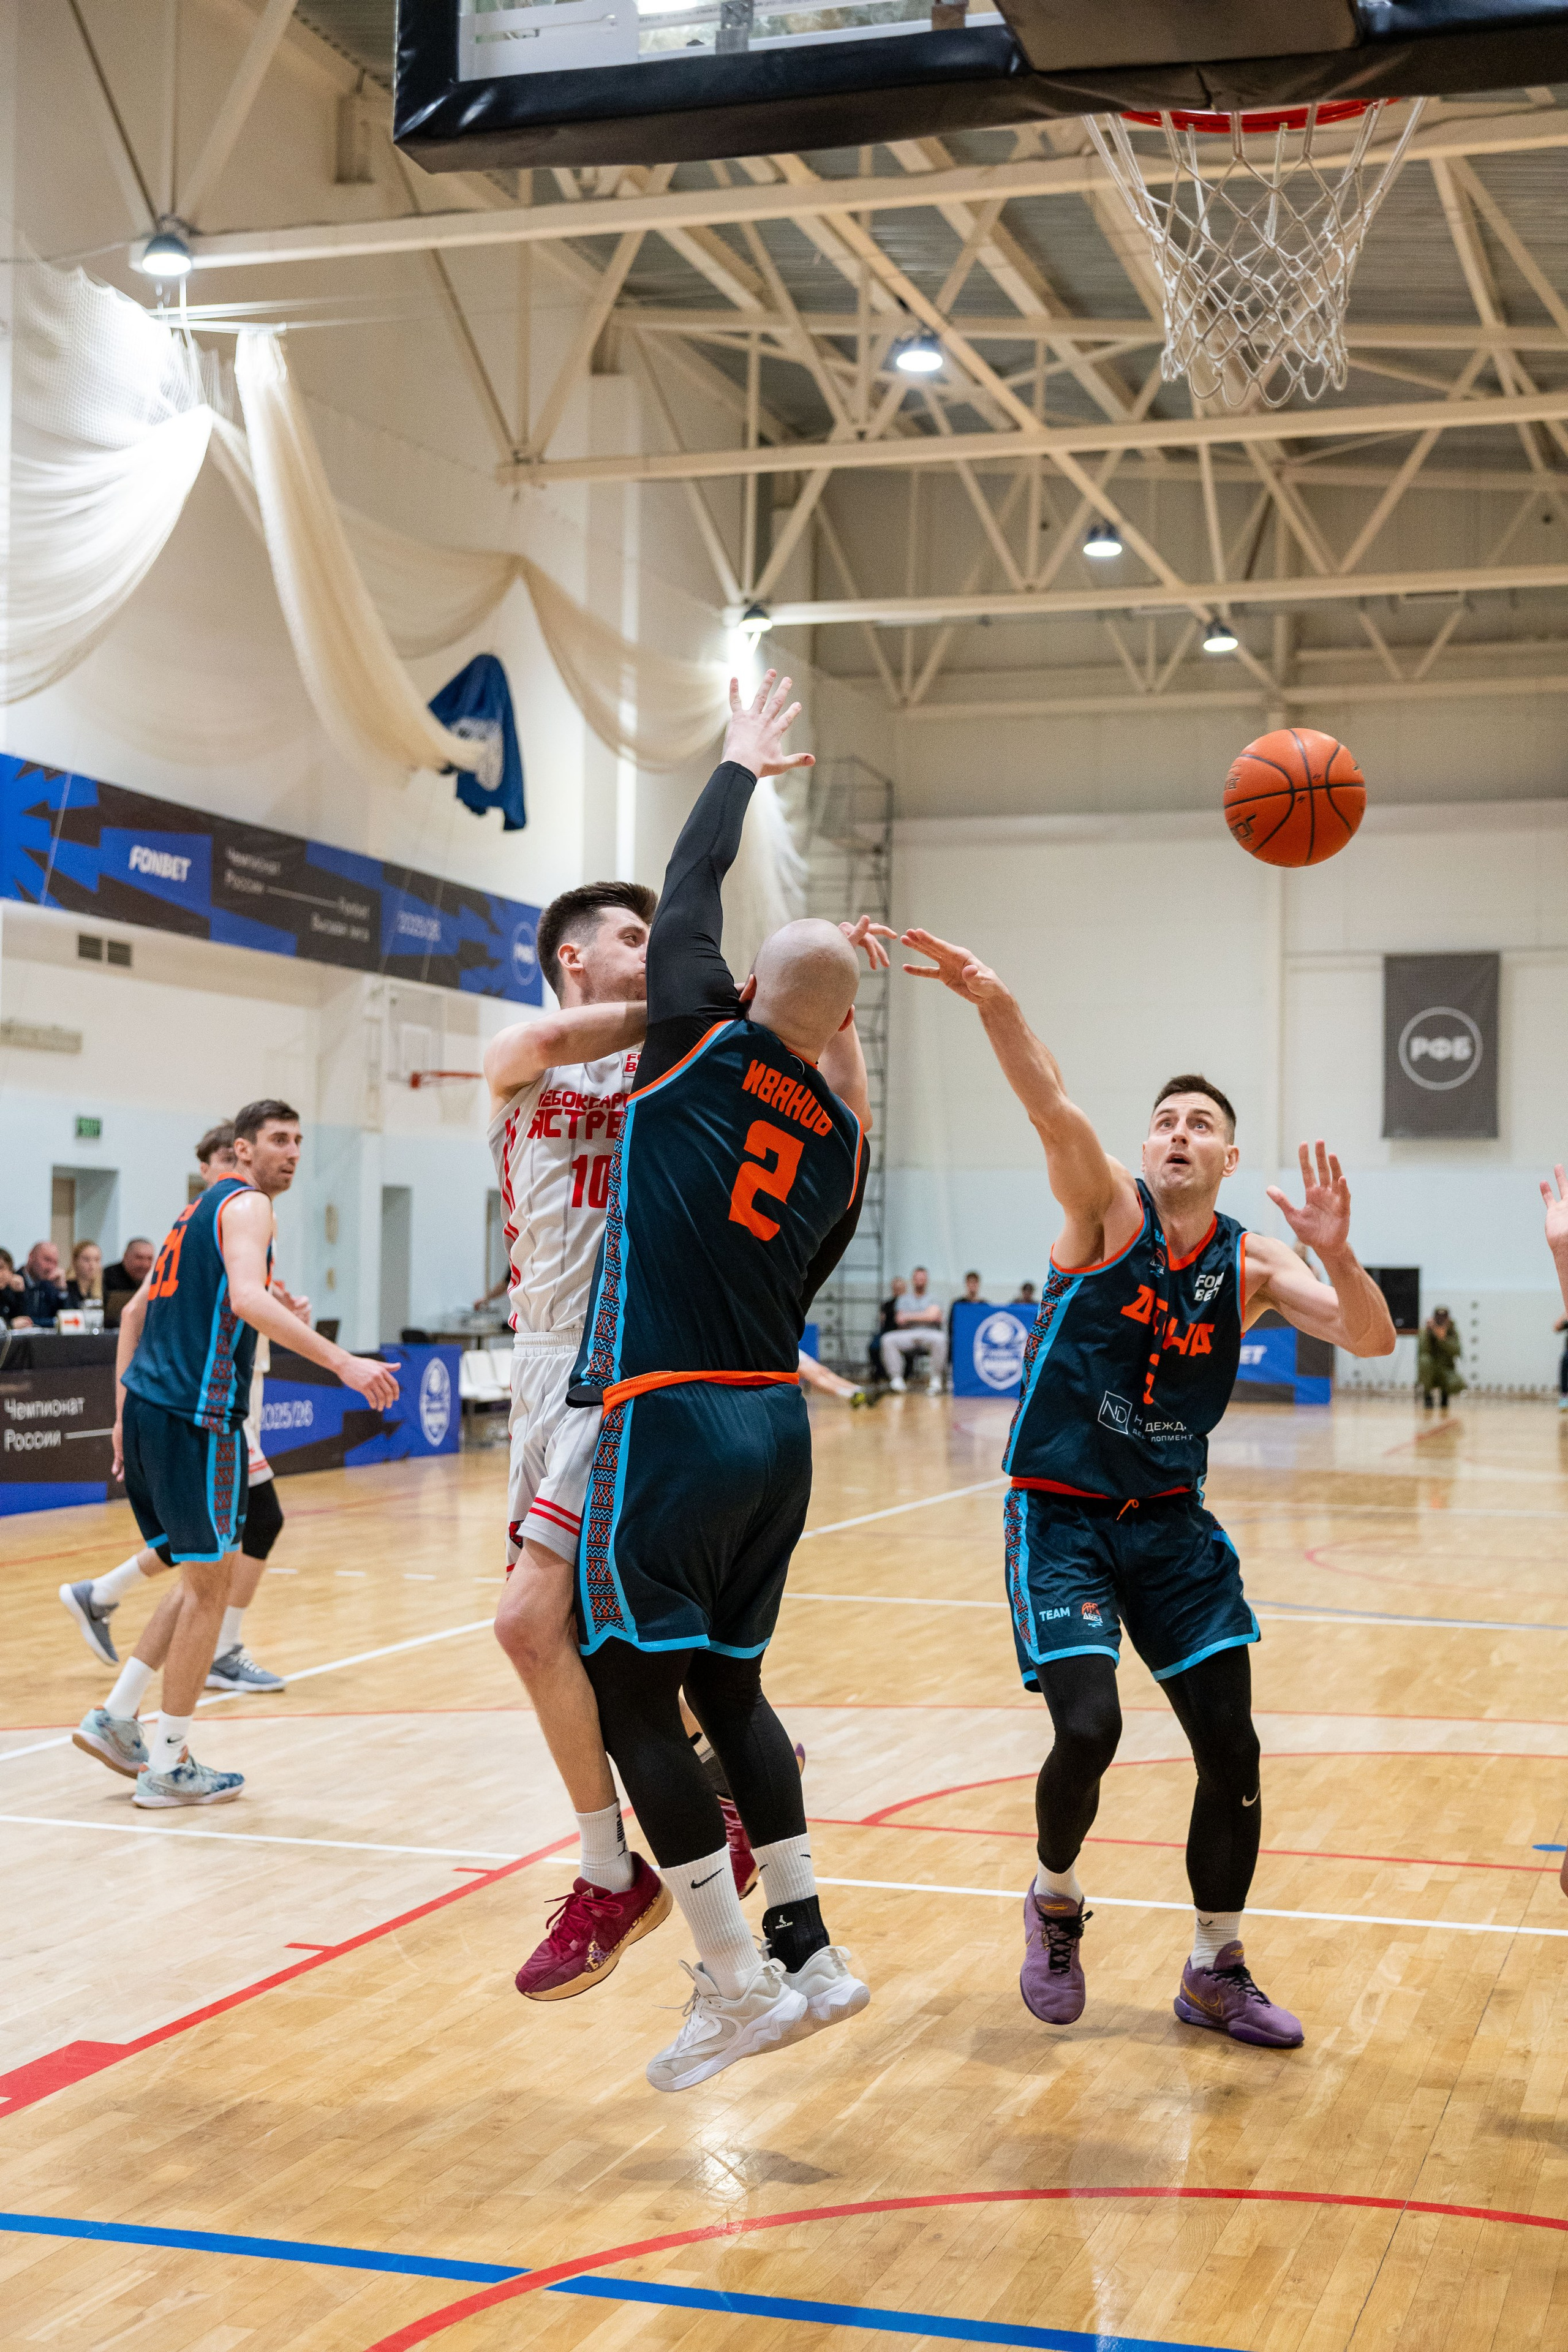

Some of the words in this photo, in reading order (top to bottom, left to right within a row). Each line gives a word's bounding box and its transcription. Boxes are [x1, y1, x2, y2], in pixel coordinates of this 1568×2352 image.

[128, 845, 192, 881] FONBET
[527, 1109, 624, 1140] ЯСТРЕ
[571, 1155, 612, 1208] 10
[728, 1120, 805, 1241] 2
[4, 1397, 85, 1420] Чемпионат
[261, 1400, 314, 1431] 025/26
[1134, 1414, 1186, 1433] НДЕЖД
[4, 1428, 61, 1452] России
[1039, 1606, 1071, 1622] TEAM
